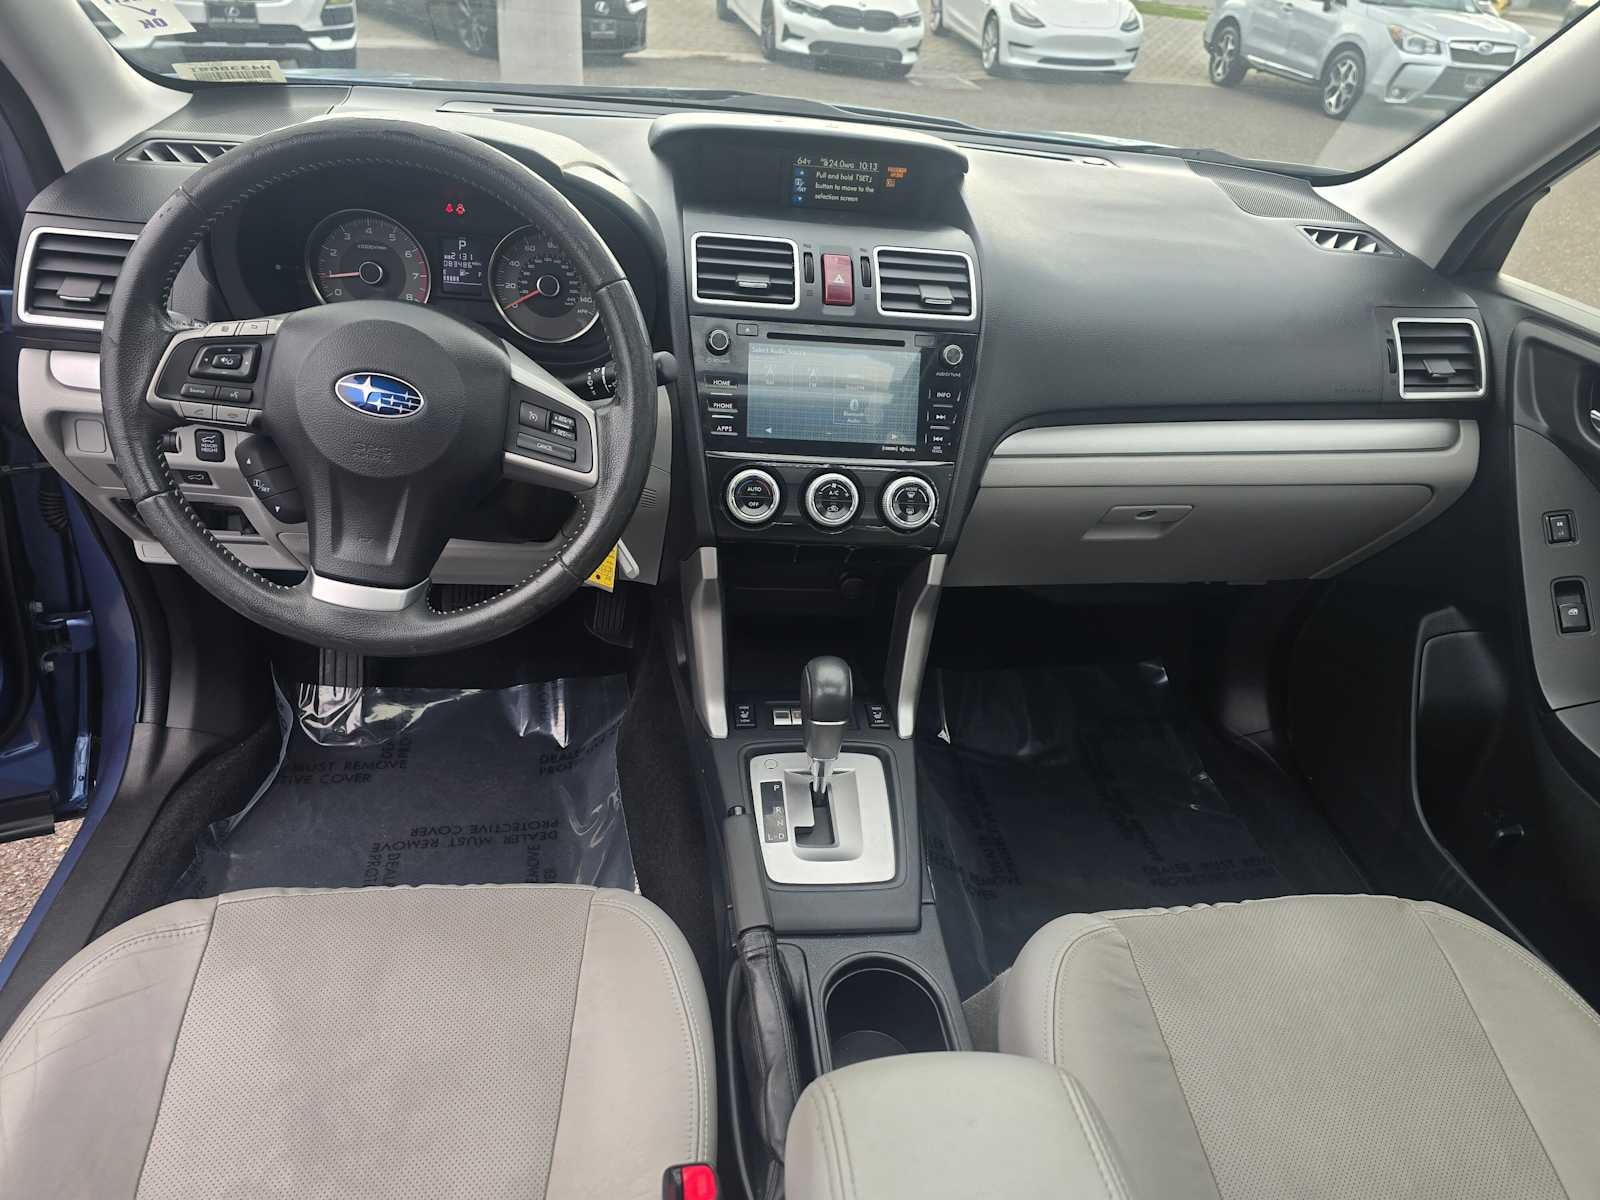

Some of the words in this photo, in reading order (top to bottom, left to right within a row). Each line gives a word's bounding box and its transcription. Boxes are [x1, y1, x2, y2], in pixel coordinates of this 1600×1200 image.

[840, 173, 853, 181] hold
[816, 182, 833, 190] button
[834, 183, 841, 191] to
[389, 233, 396, 241] 5
[458, 239, 467, 251] P
[404, 250, 412, 258] 6
[412, 272, 419, 280] 7
[334, 288, 342, 296] 0
[406, 293, 413, 301] 8
[713, 379, 731, 387] HOME
[343, 758, 408, 771] REMOVE
[319, 773, 372, 785] COVER
[410, 825, 462, 837] COVER
[466, 818, 559, 835] PROTECTIVE
[448, 835, 493, 848] MUST
[503, 829, 558, 845] DEALER
[371, 838, 440, 852] REMOVE
